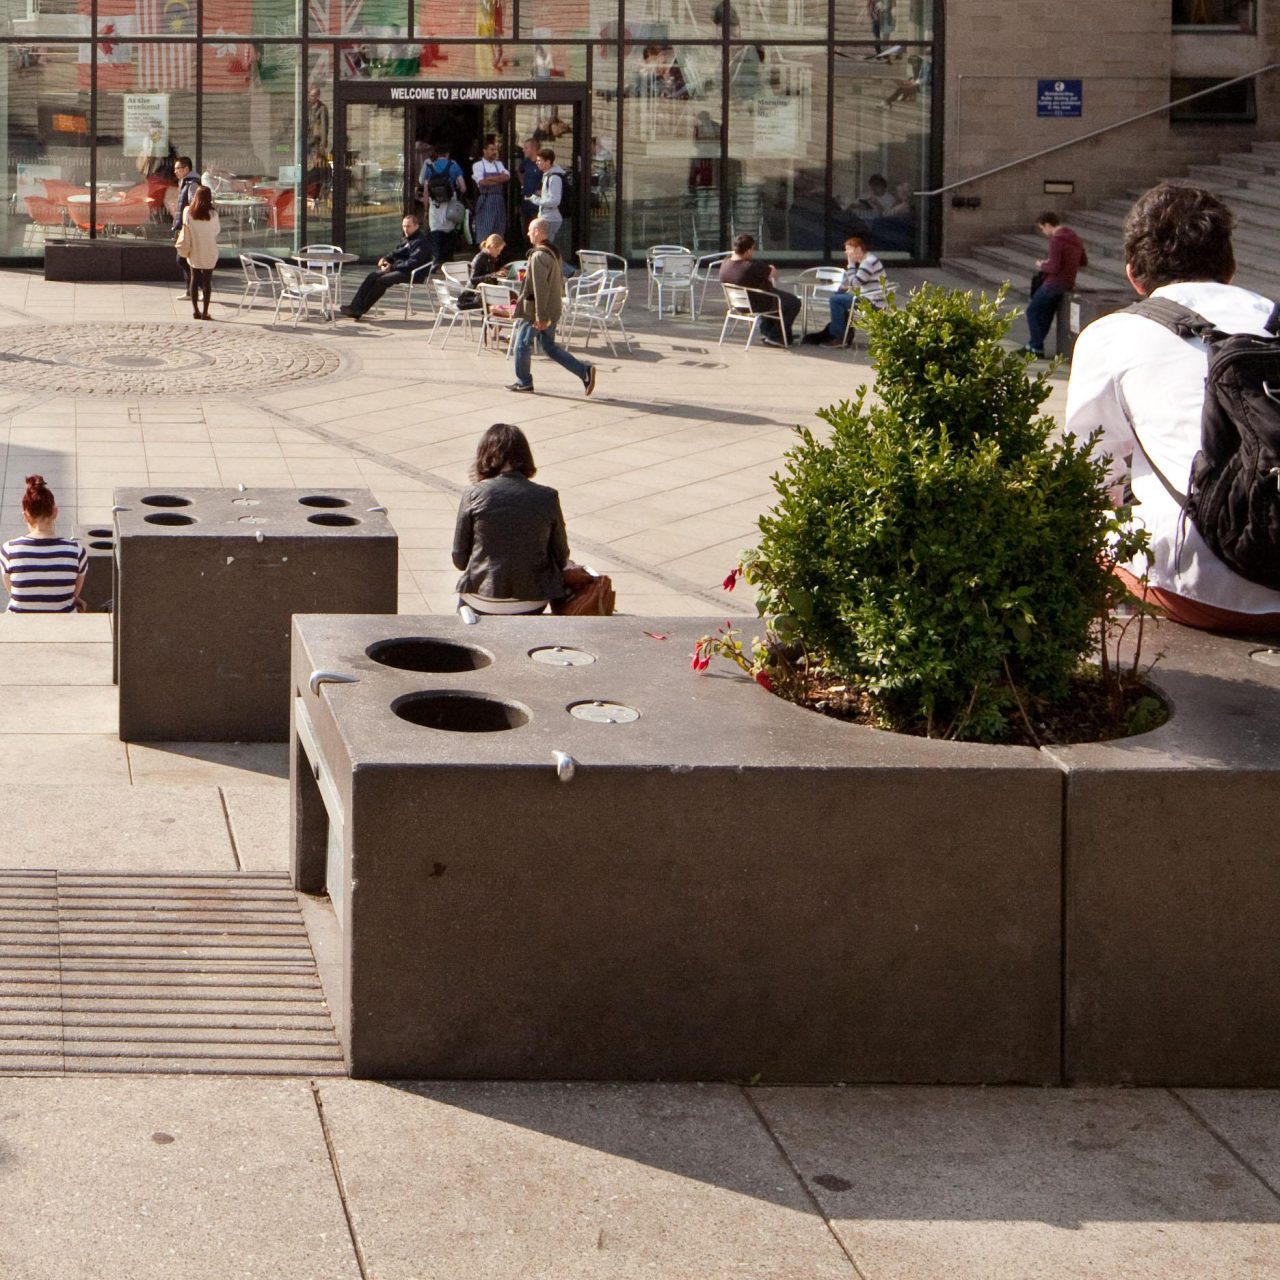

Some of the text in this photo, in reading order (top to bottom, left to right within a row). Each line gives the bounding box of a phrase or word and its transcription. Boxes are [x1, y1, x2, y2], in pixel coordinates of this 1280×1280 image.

[391, 88, 435, 99] WELCOME
[437, 88, 449, 99] TO
[460, 88, 498, 99] CAMPUS
[499, 88, 537, 99] KITCHEN
